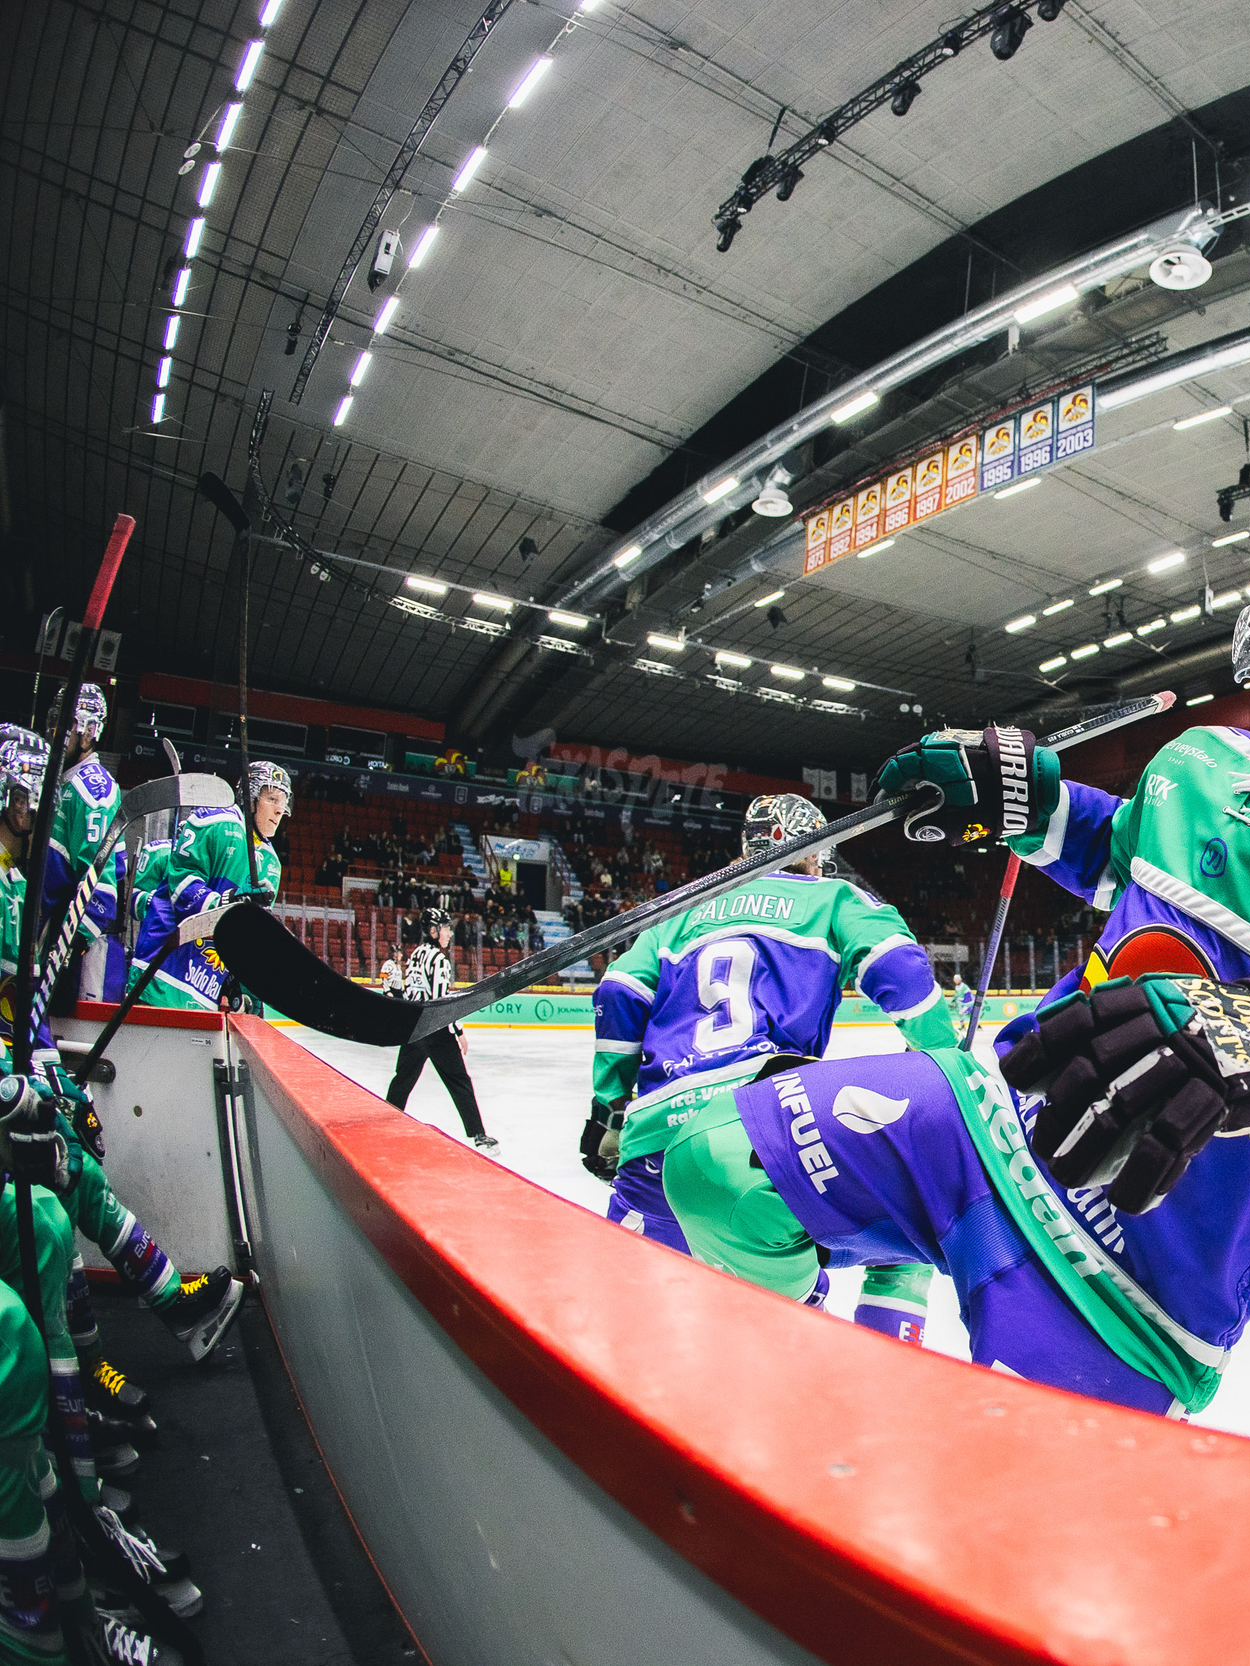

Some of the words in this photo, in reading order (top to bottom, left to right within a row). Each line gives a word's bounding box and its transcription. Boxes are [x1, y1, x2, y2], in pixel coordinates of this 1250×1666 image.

[1057, 431, 1094, 459] 2003
[1019, 446, 1051, 474] 1996
[982, 462, 1013, 490] 1995
[945, 477, 976, 504] 2002
[915, 493, 941, 519] 1997
[884, 507, 909, 534] 1996
[829, 535, 850, 560] 1992
[854, 522, 878, 548] 1994
[806, 548, 825, 573] 1973
[1165, 740, 1218, 767] erveystalo
[1167, 756, 1185, 766] SPORT
[993, 721, 1031, 839] WARRIO
[1145, 773, 1179, 800] RTK
[690, 894, 795, 926] SALONEN
[692, 938, 757, 1054] 9
[772, 1072, 839, 1194] INFUEL
